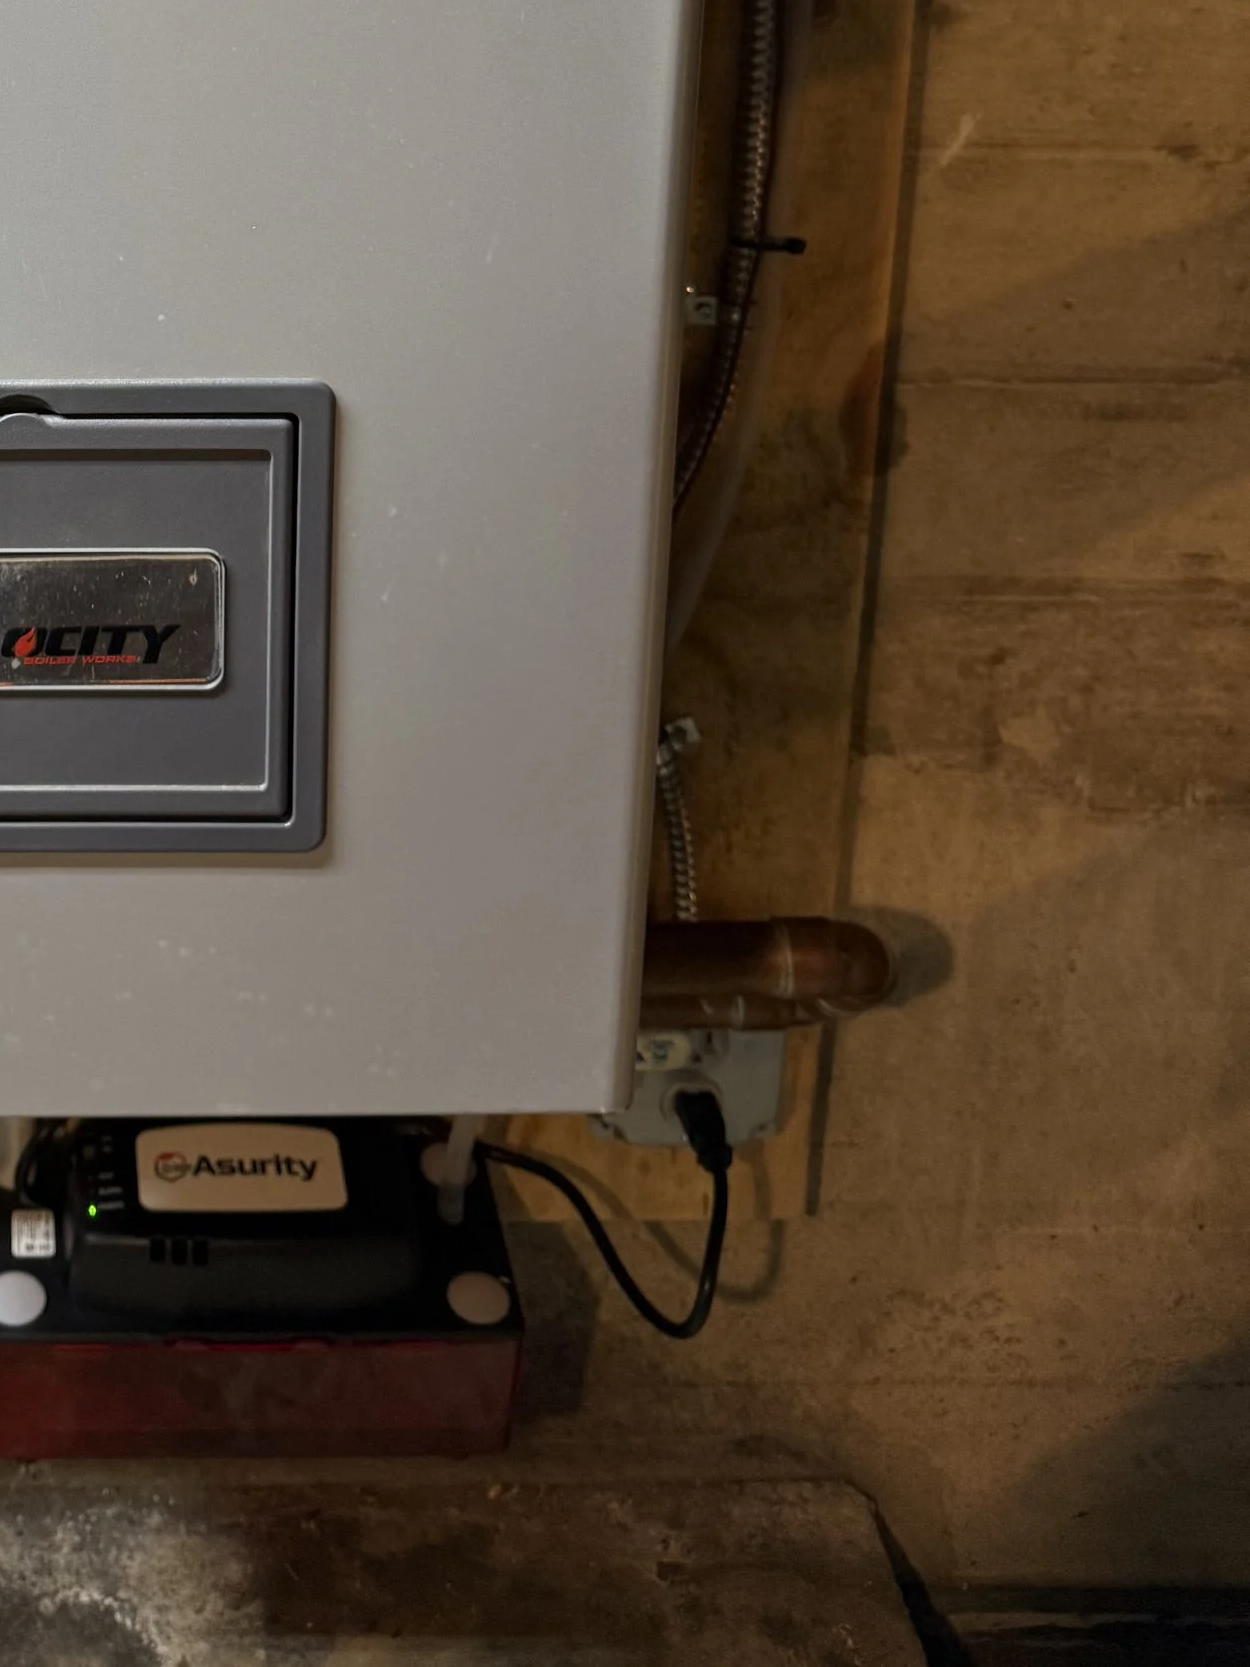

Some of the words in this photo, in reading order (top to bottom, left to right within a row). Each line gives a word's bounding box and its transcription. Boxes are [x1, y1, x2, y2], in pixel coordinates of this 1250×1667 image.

[22, 655, 76, 665] BOILER
[82, 654, 137, 664] WORKS
[190, 1152, 320, 1182] Asurity
